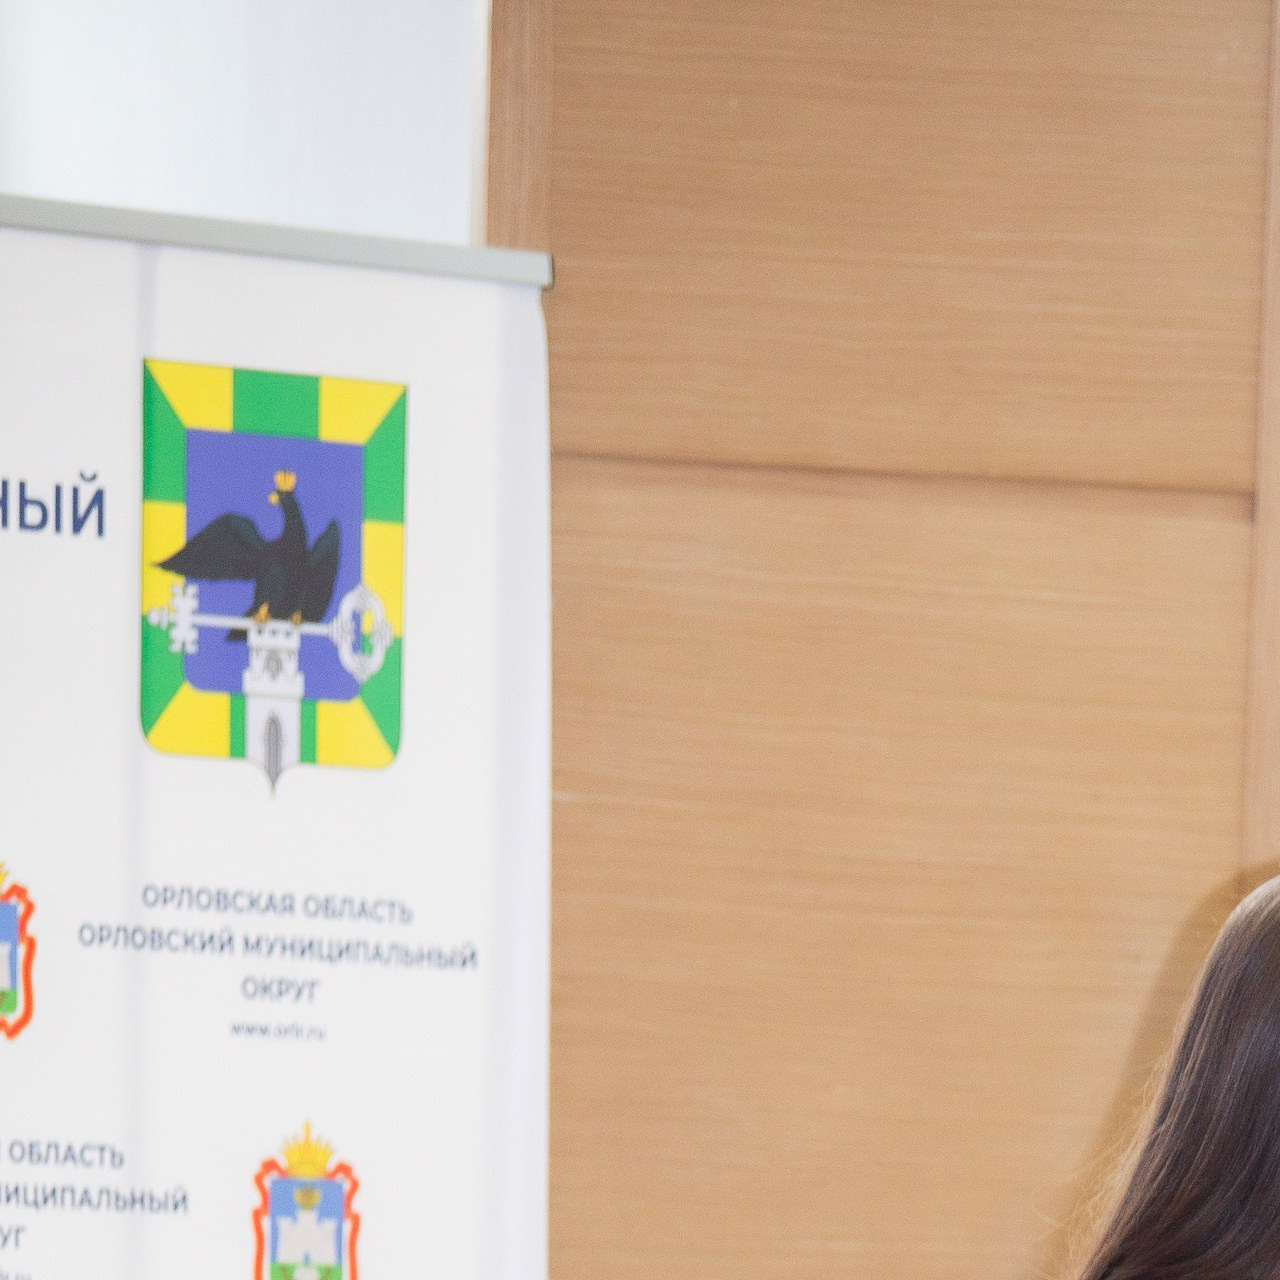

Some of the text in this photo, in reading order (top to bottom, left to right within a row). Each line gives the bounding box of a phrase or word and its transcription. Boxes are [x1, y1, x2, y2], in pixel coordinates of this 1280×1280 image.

[141, 884, 413, 925] ОРЛОВСКАЯ ОБЛАСТЬ
[78, 922, 478, 970] ОРЛОВСКИЙ МУНИЦИПАЛЬНЫЙ
[241, 976, 319, 1002] ОКРУГ
[8, 1139, 125, 1169] ОБЛАСТЬ
